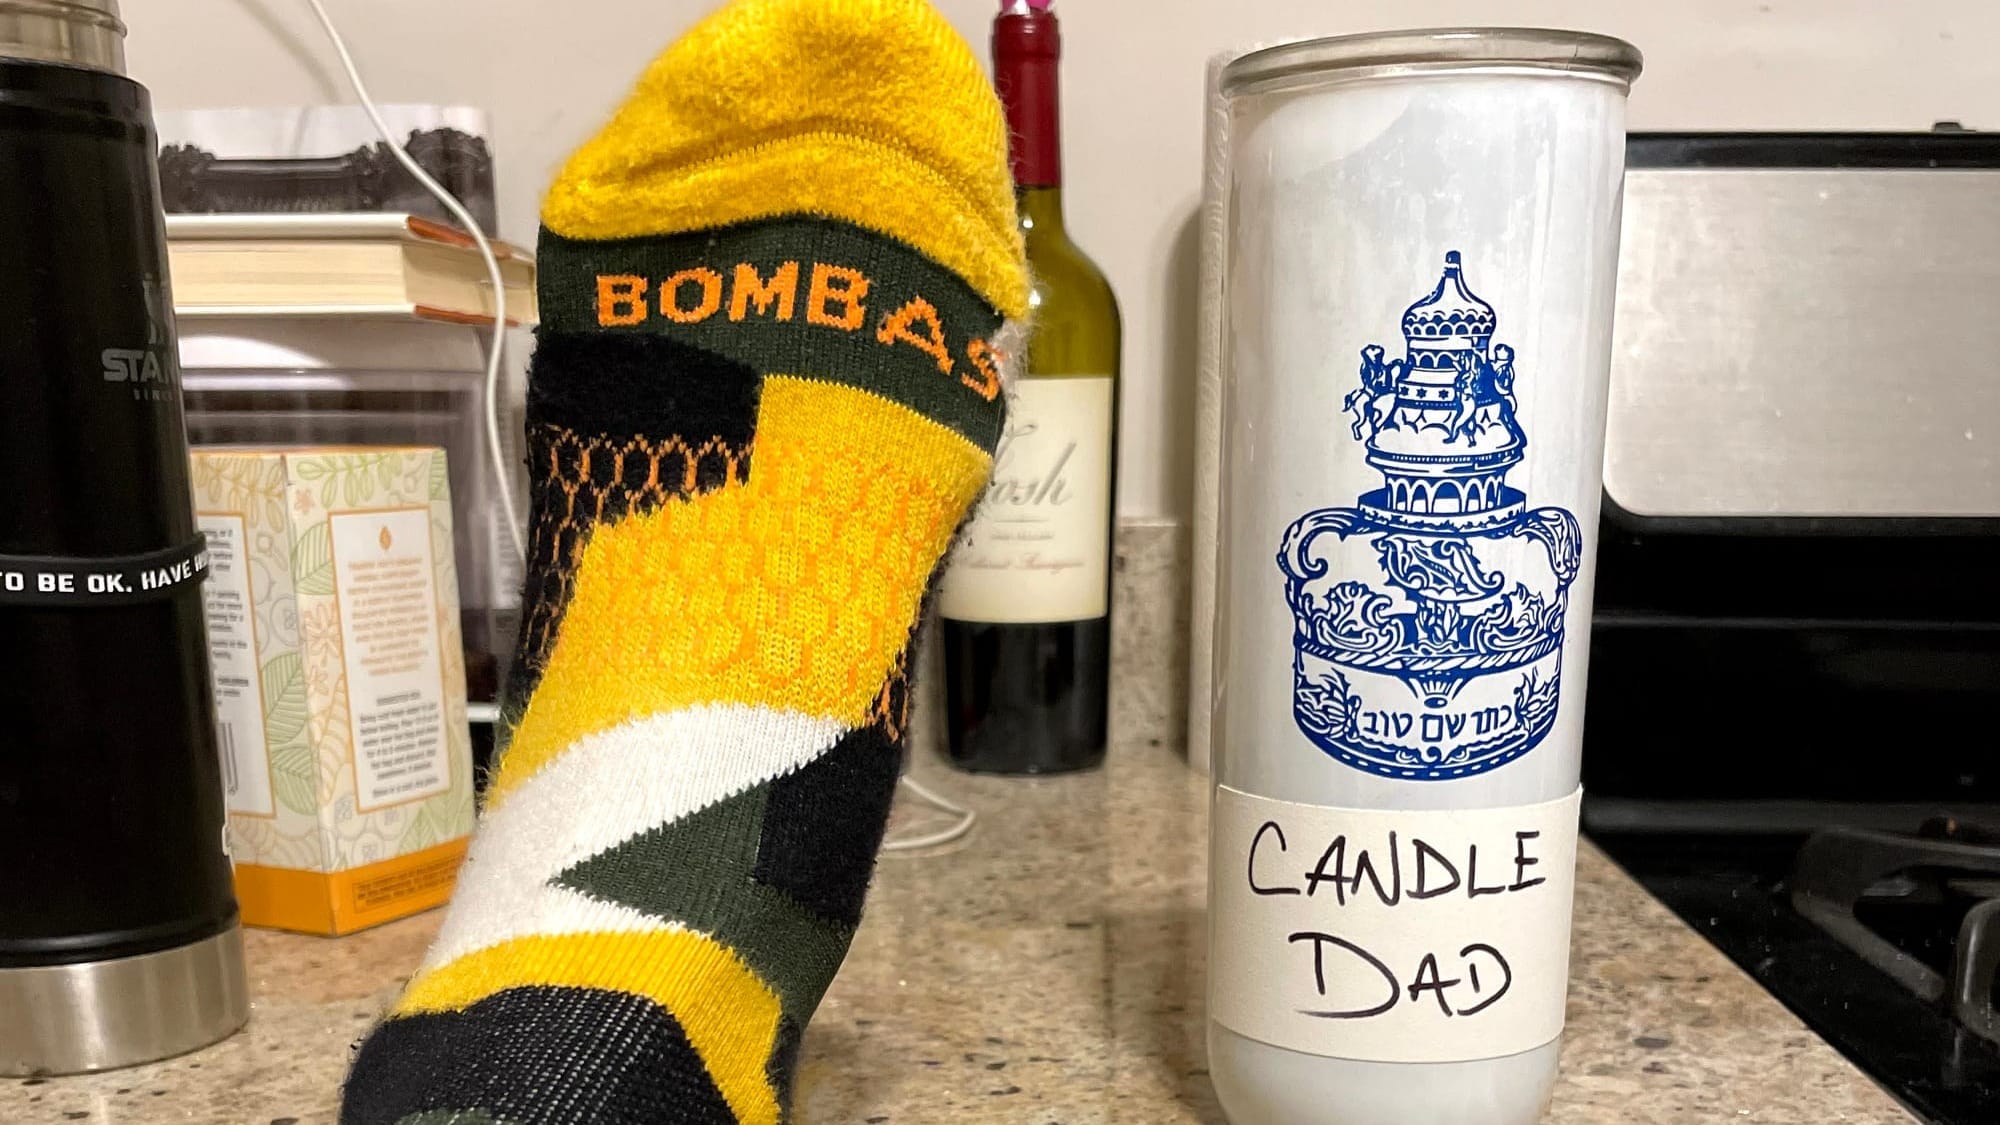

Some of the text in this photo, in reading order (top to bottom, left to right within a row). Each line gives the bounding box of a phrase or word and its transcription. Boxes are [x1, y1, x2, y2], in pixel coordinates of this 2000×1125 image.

[596, 260, 1004, 402] BOMBAS
[0, 571, 24, 591] O
[37, 573, 75, 592] BE
[87, 574, 133, 593] OK.
[141, 559, 192, 590] HAVE
[1363, 710, 1413, 739] טוב
[1420, 712, 1466, 743] שם
[1248, 821, 1547, 906] CANDLE
[1288, 931, 1513, 1019] DAD
